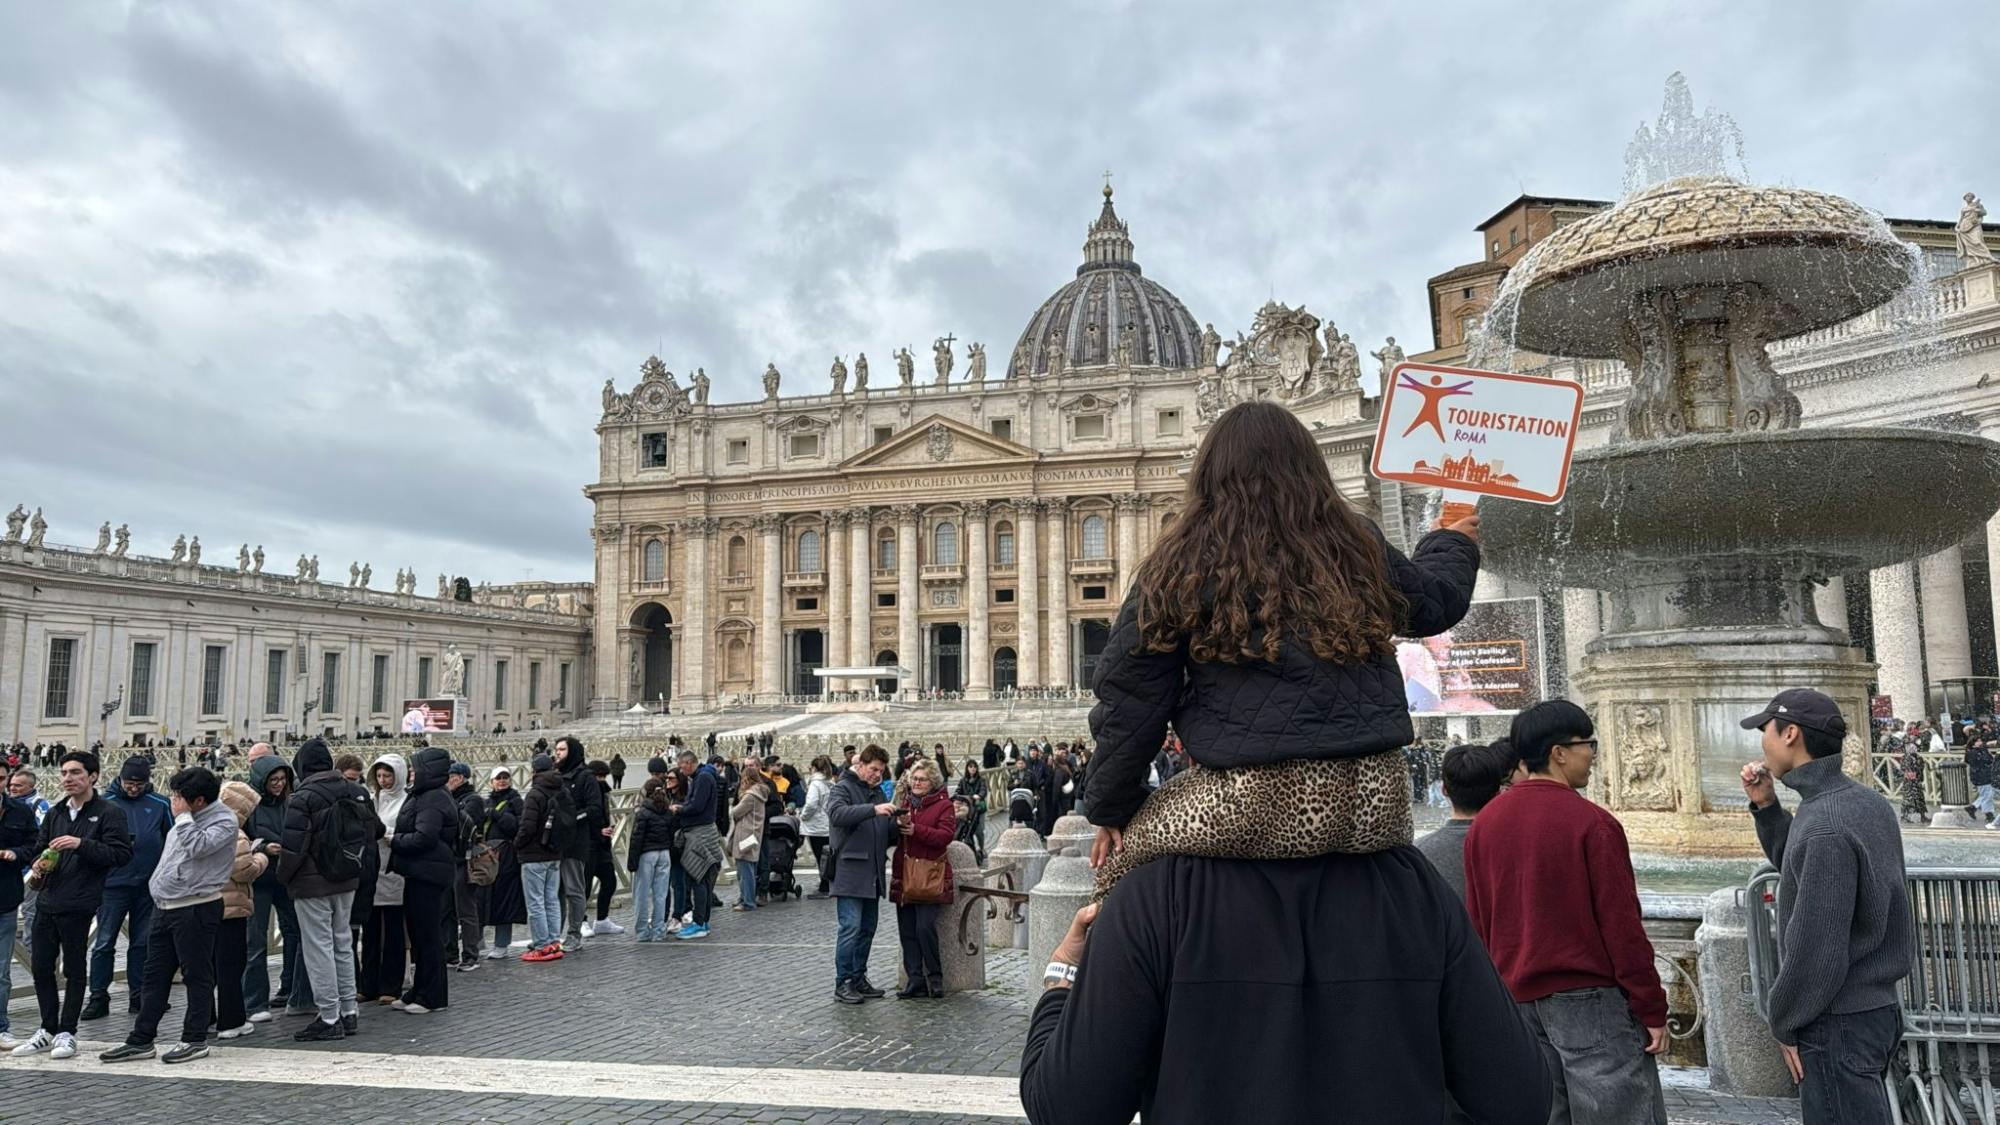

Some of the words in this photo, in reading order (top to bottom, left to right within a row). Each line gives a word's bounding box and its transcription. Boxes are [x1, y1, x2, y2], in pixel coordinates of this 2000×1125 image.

[1448, 407, 1569, 439] TOURISTATION
[1453, 428, 1487, 444] ROMA
[688, 492, 700, 503] IN
[708, 490, 762, 503] HONOREM
[973, 471, 1033, 485] ROMANVS
[1475, 657, 1516, 665] Confession
[1484, 682, 1520, 690] Adoration
